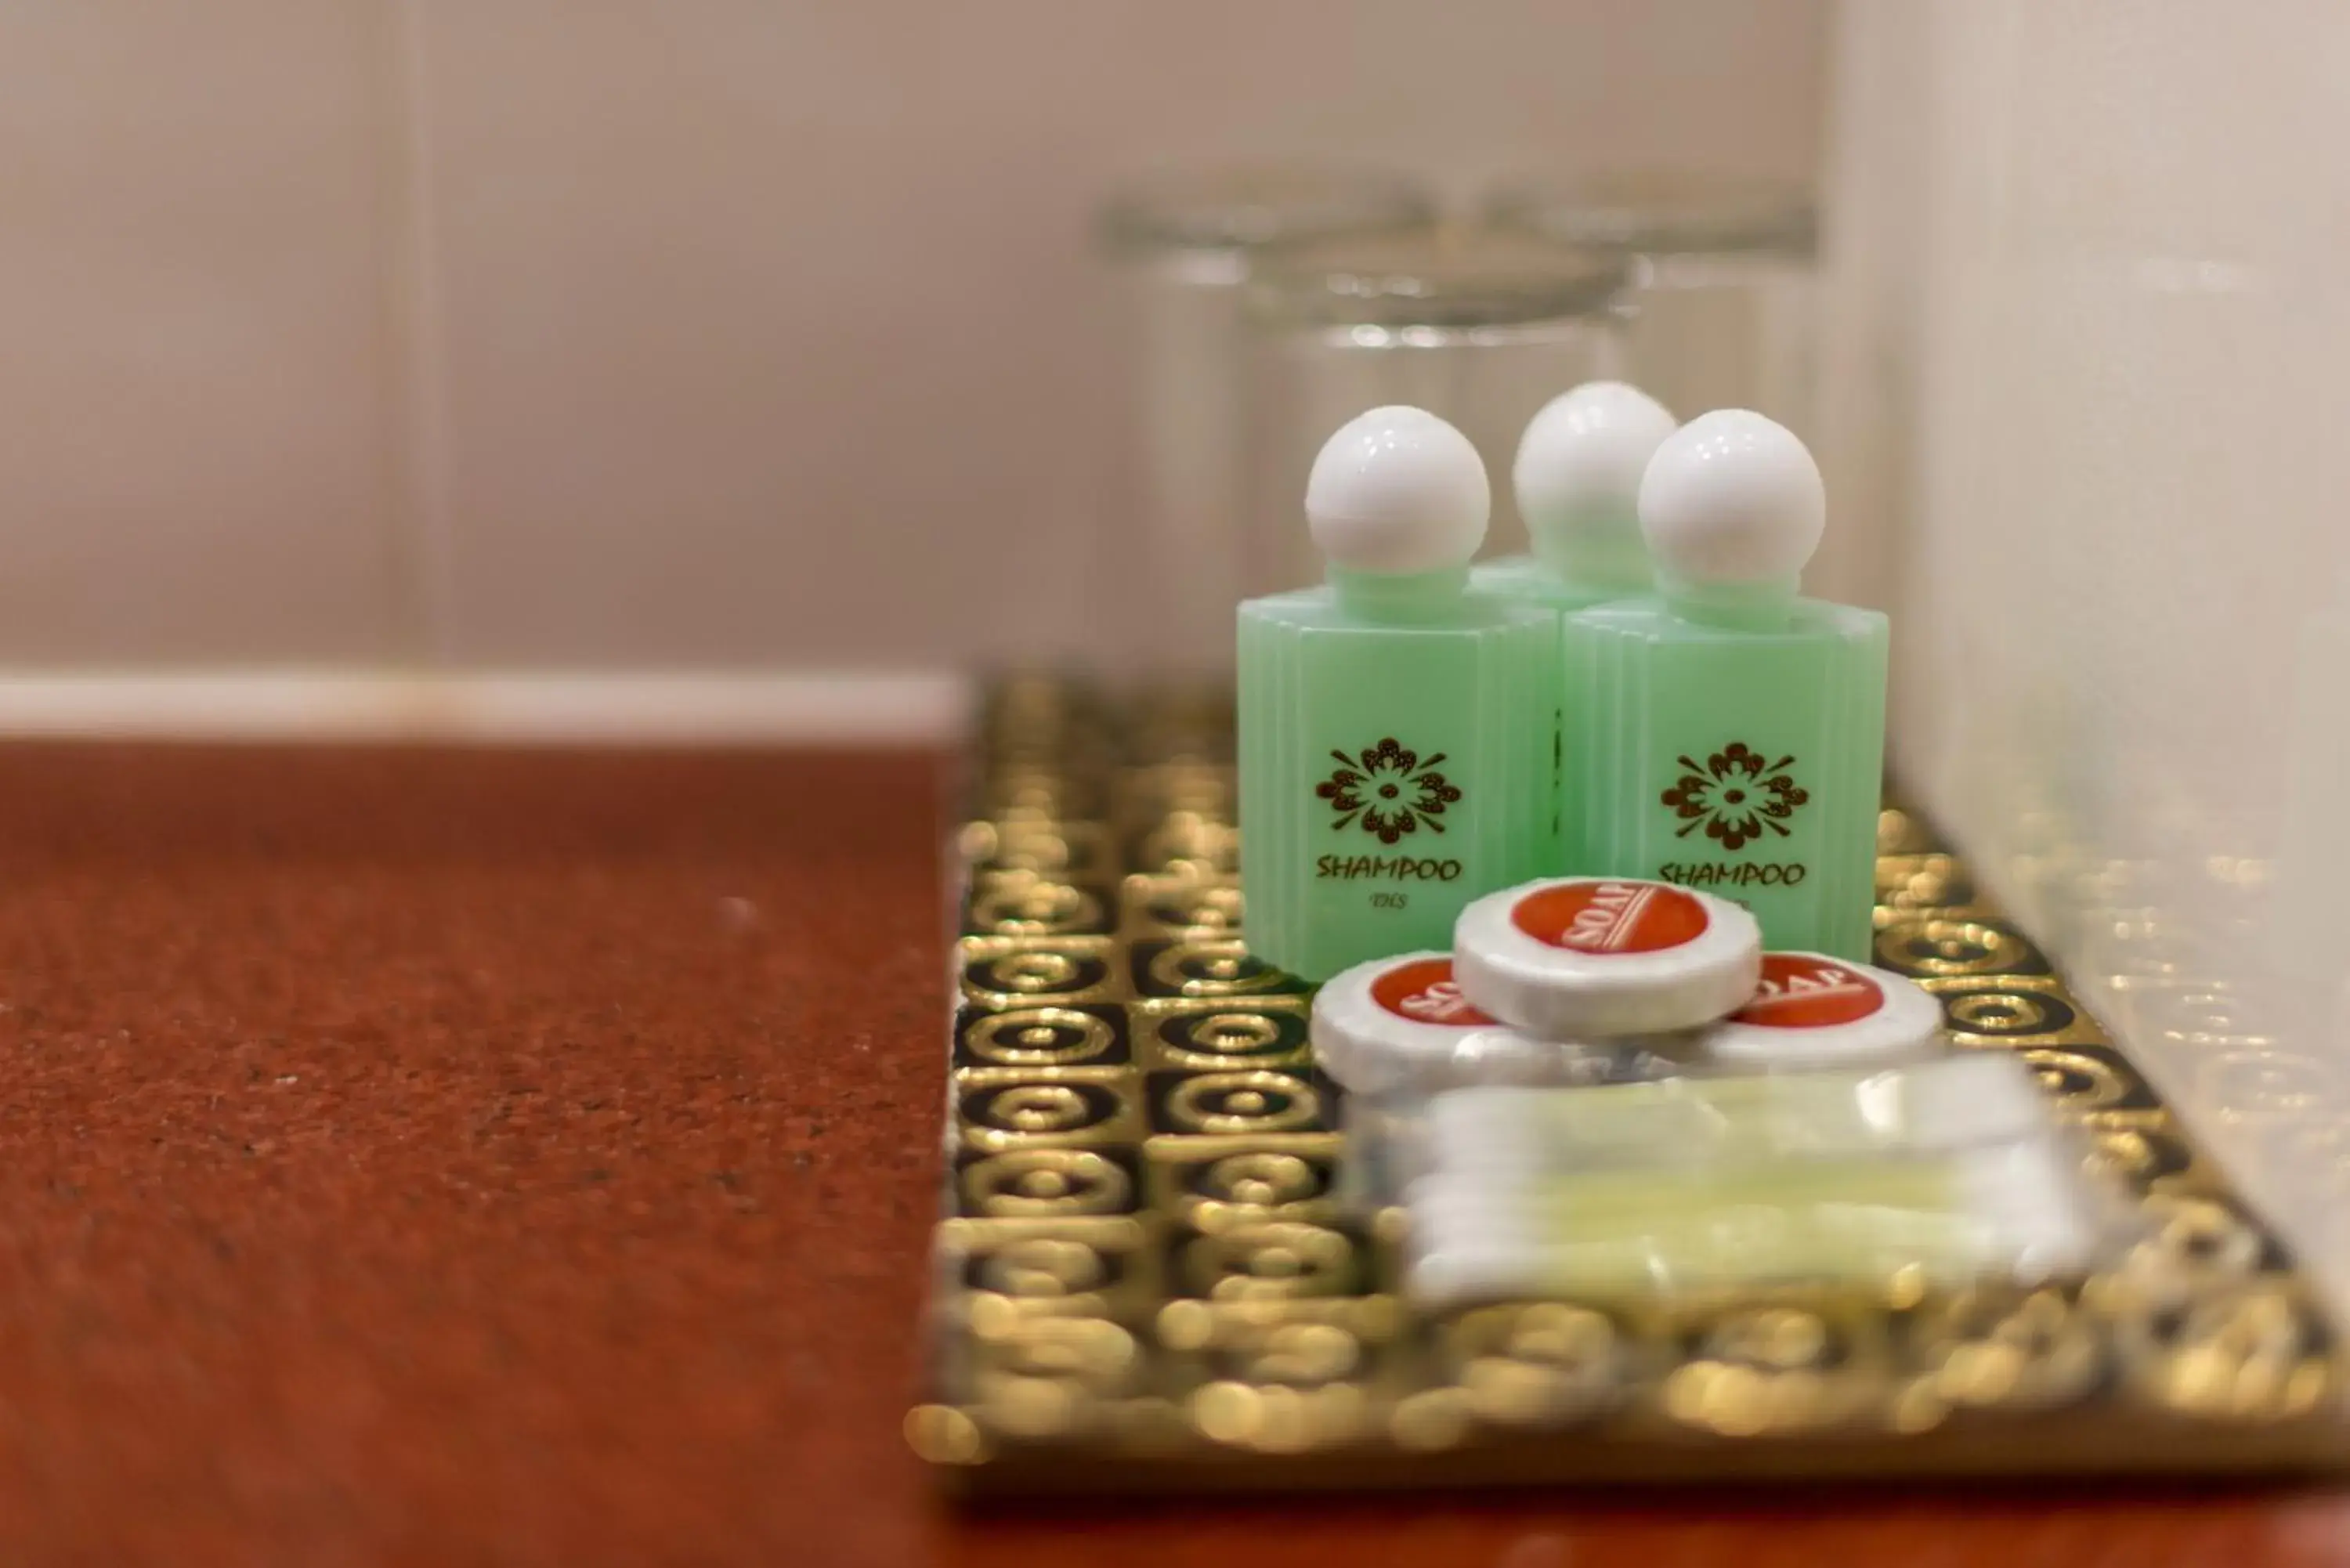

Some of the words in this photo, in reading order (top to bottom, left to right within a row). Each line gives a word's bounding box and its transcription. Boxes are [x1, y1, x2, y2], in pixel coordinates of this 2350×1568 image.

[1315, 854, 1462, 881] SHAMPOO
[1658, 862, 1806, 887] SHAMPOO
[1561, 883, 1637, 948] SOAP
